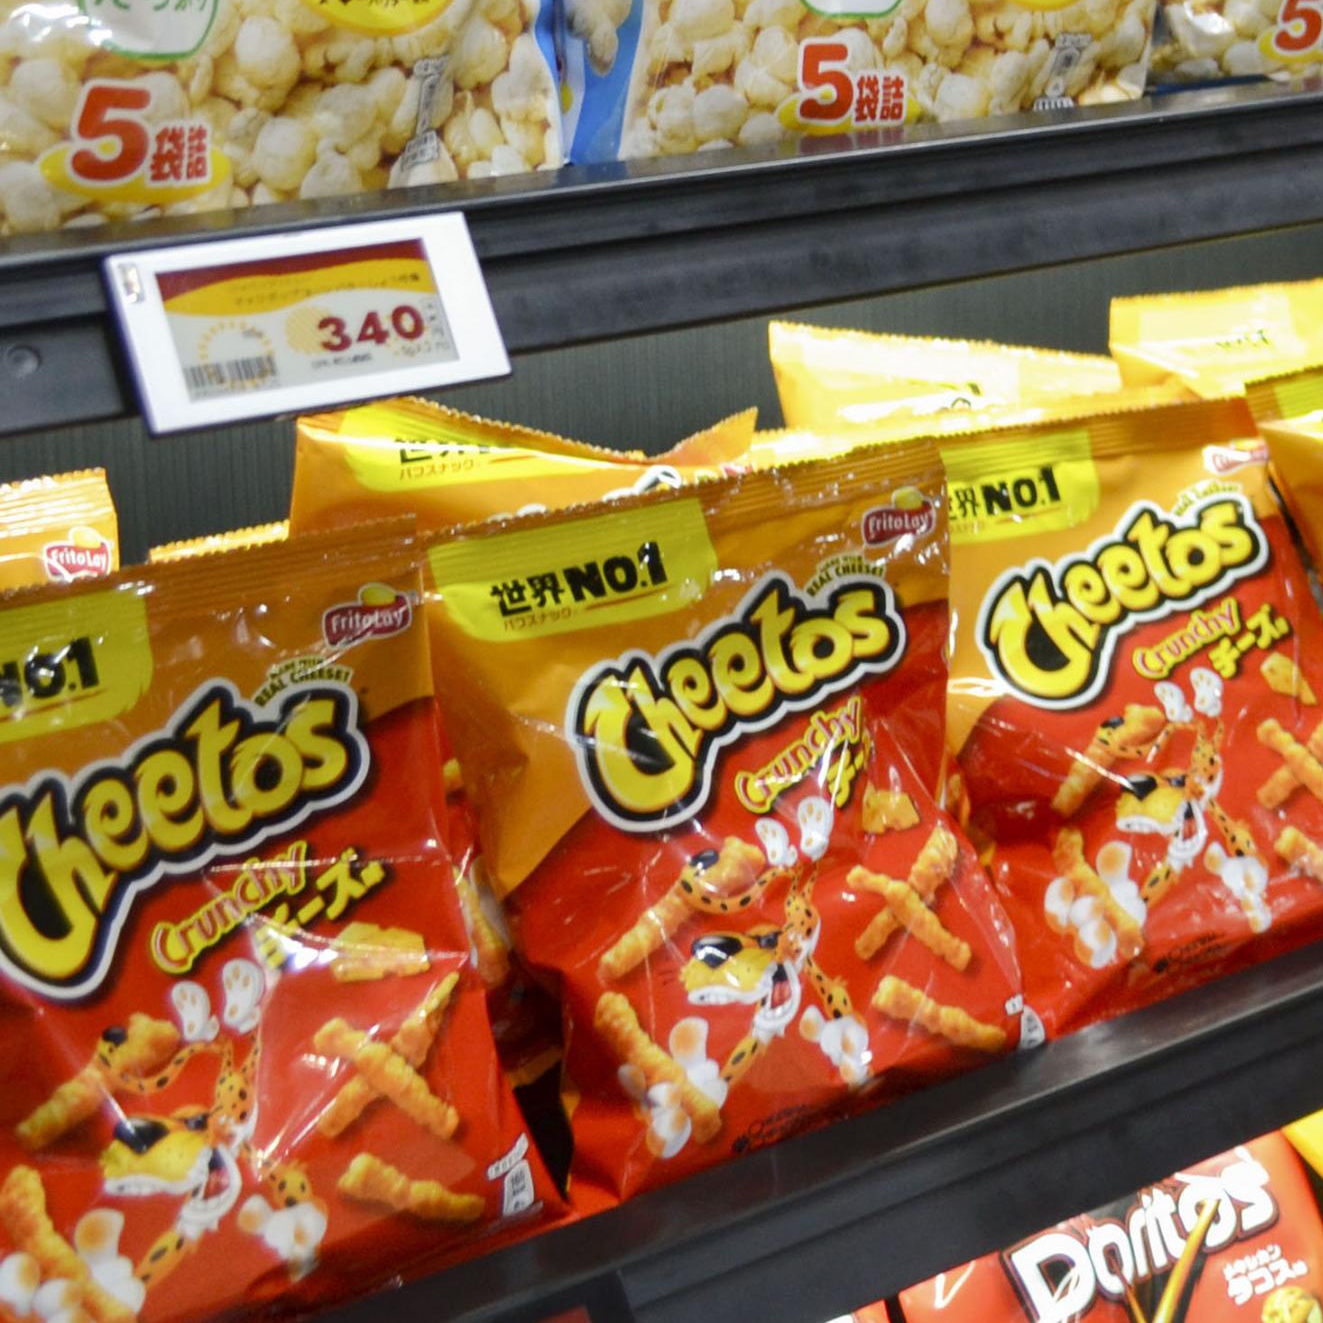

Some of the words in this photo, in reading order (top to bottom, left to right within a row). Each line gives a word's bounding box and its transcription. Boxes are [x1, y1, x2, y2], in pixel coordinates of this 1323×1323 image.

[70, 85, 209, 181] 5袋詰
[798, 41, 905, 124] 5袋詰
[317, 303, 425, 352] 340
[489, 540, 669, 616] 世界NO.1
[985, 500, 1262, 700] Cheetos
[1133, 597, 1242, 680] Crunchy
[574, 574, 898, 822] Cheetos
[0, 688, 354, 984] Cheetos
[152, 840, 310, 974] Crunchy
[1008, 1158, 1276, 1323] Doritos
